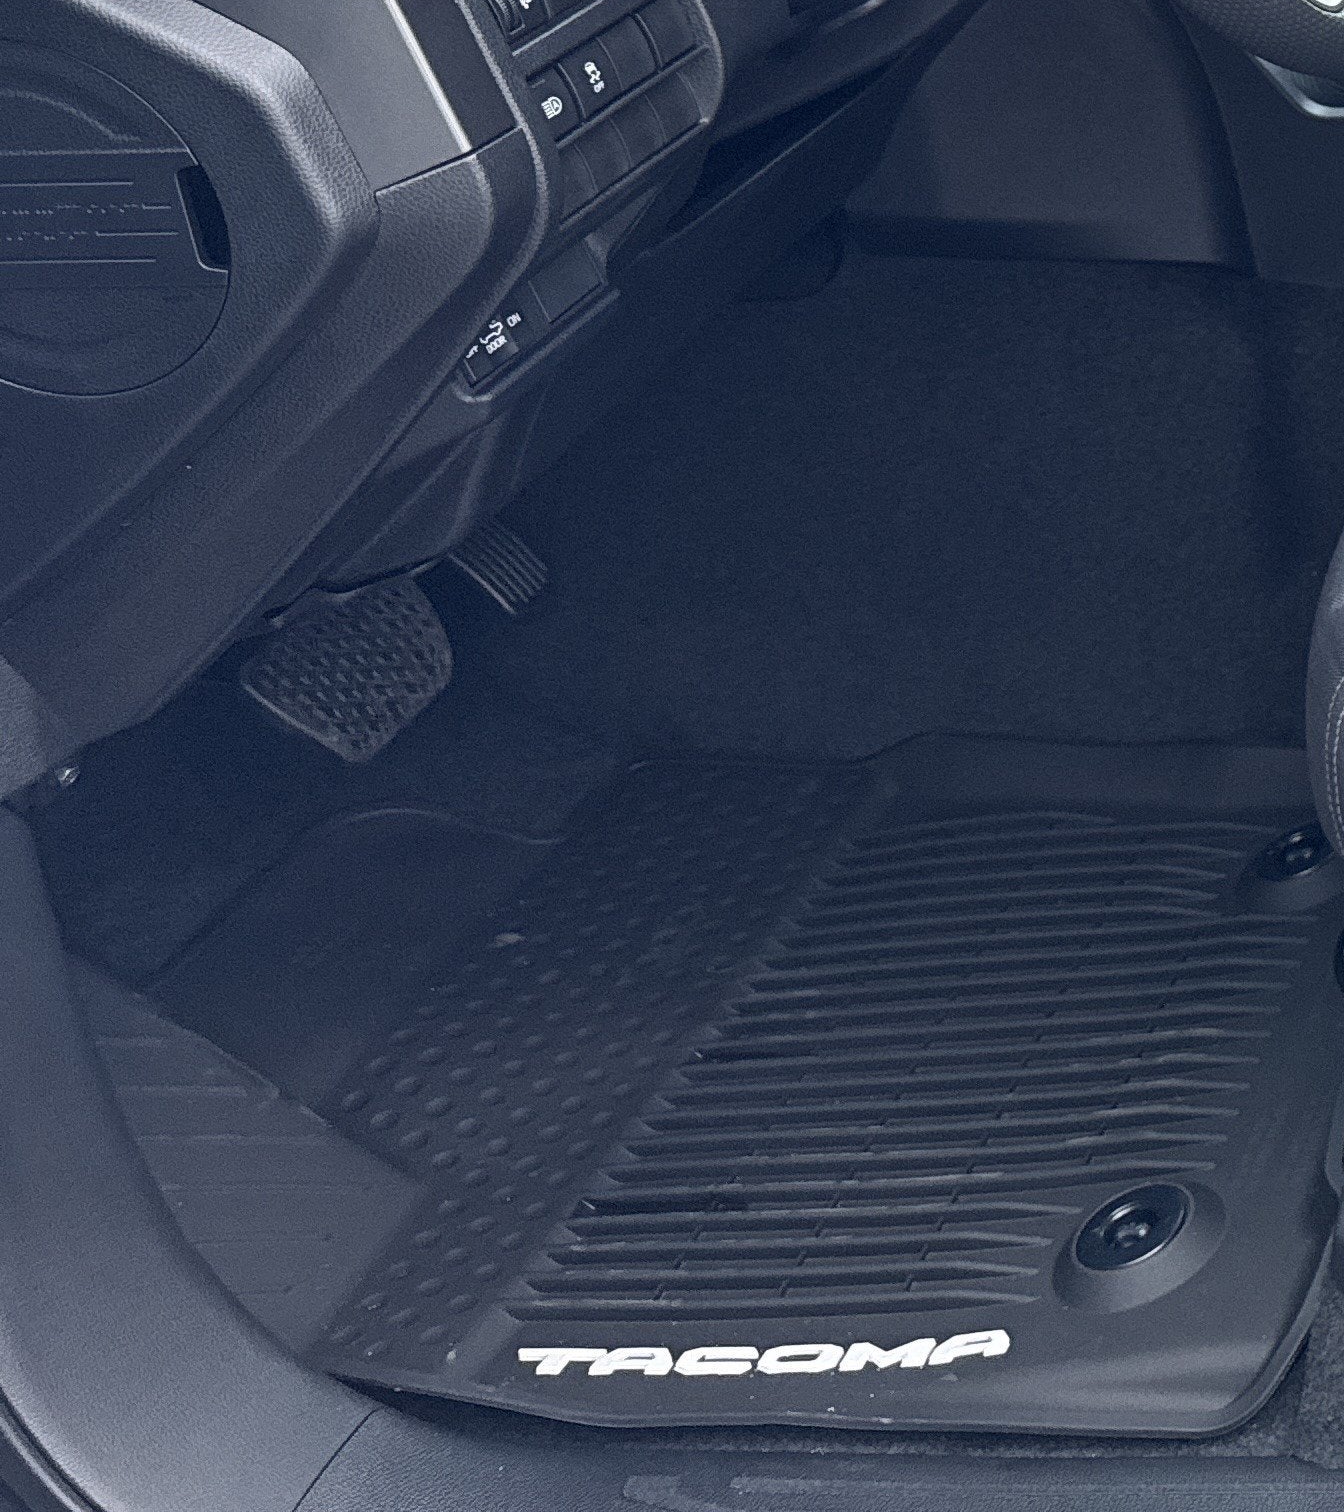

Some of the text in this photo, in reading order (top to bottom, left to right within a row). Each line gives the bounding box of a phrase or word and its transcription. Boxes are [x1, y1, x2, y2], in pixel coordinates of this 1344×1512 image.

[506, 312, 521, 328] ON
[485, 335, 508, 355] DOOR
[517, 1328, 1011, 1377] TACOMA
